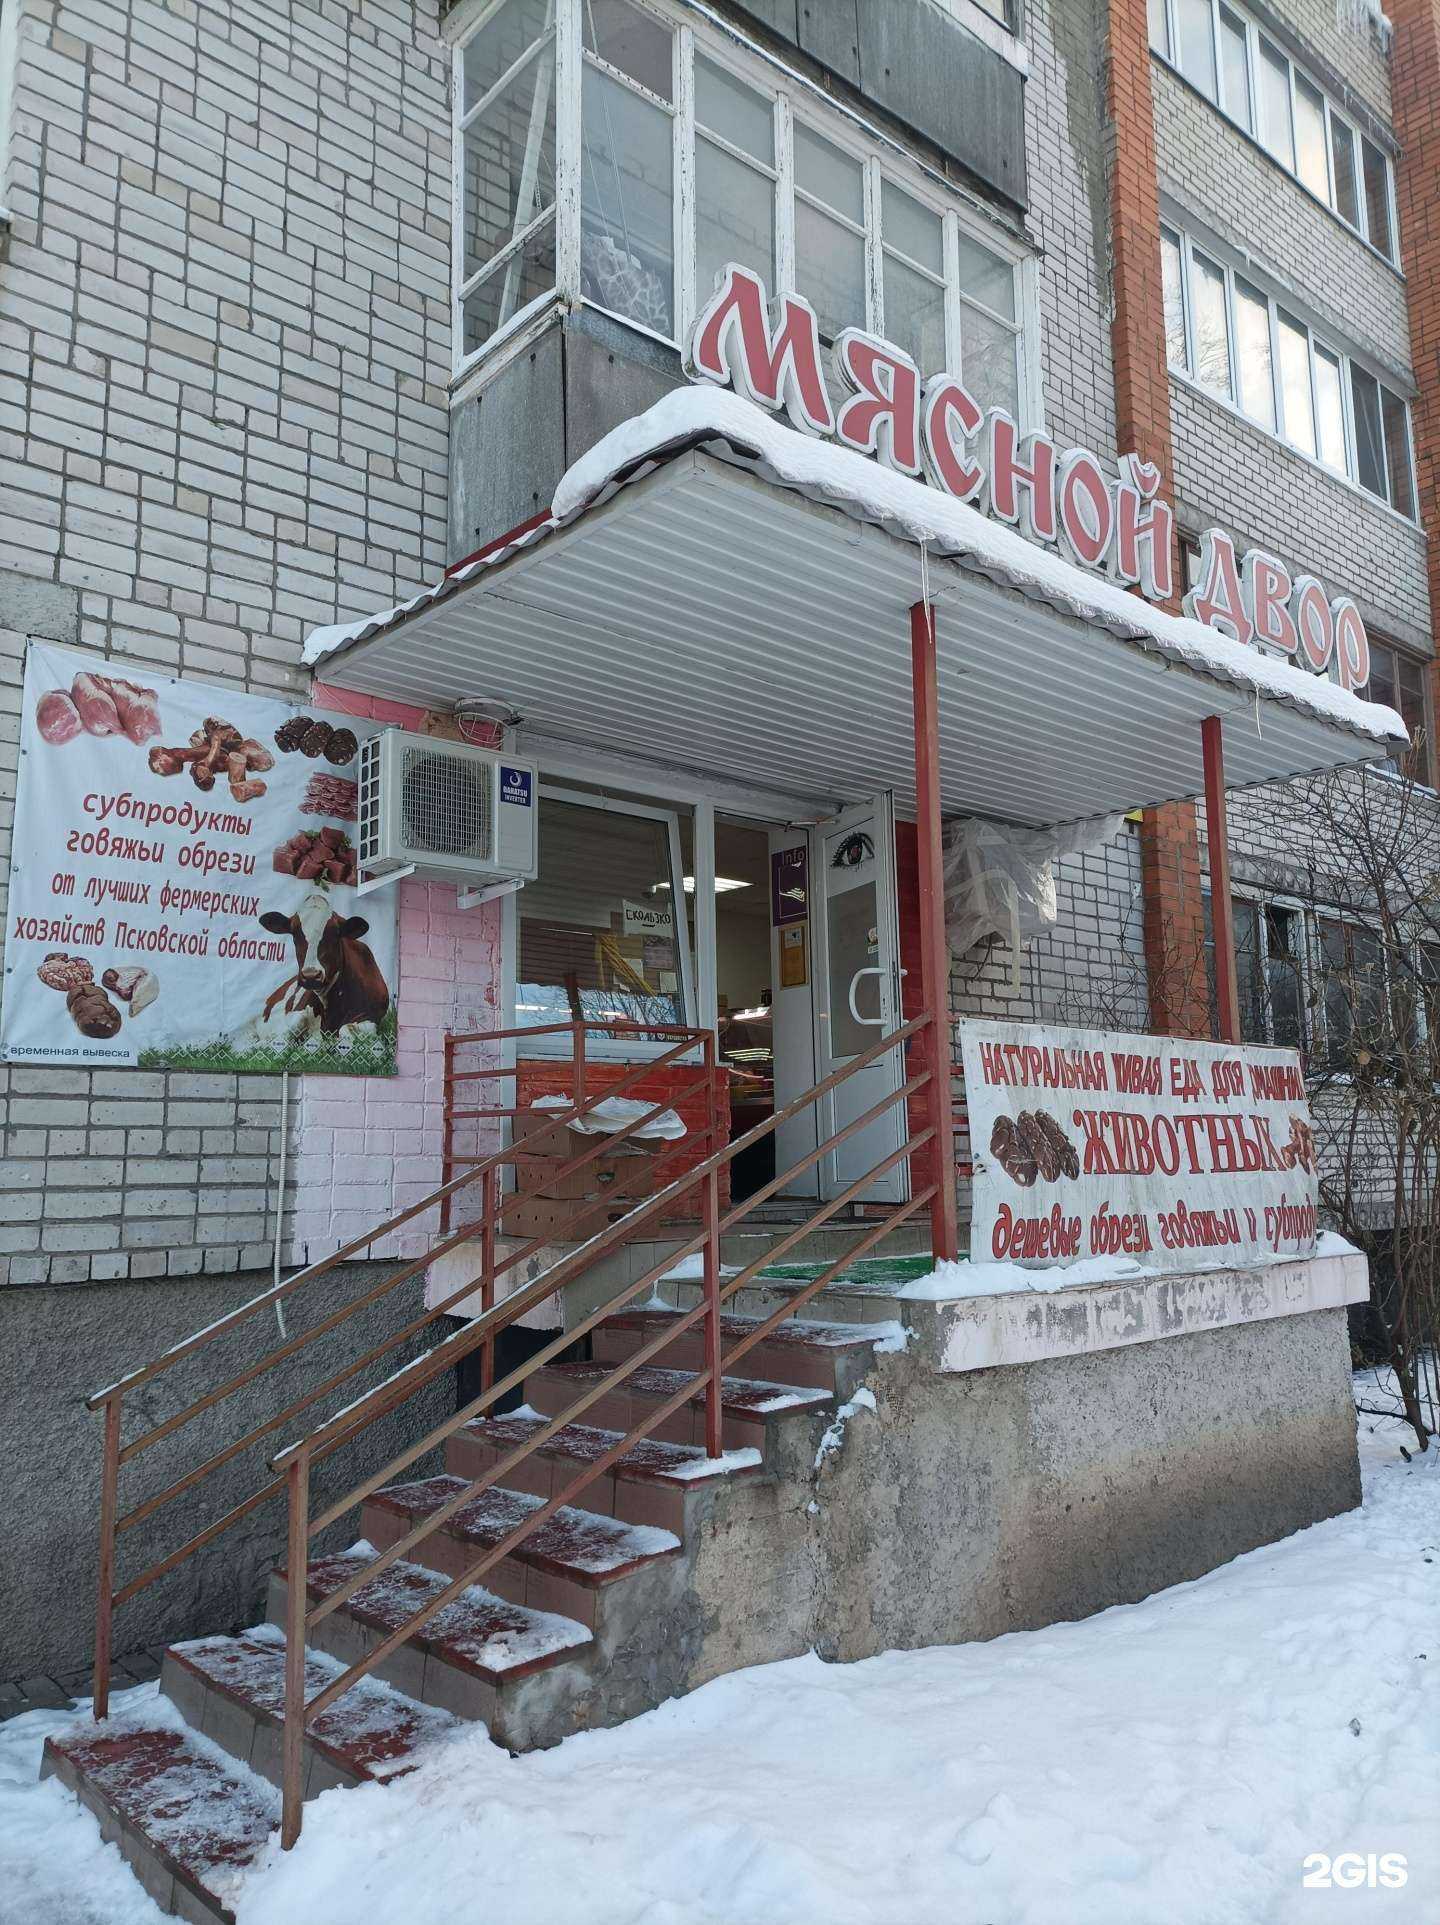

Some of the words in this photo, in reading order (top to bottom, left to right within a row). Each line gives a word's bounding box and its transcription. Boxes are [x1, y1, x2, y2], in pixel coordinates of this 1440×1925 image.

[83, 792, 253, 836] субпродукты
[66, 827, 165, 864] говяжьи
[178, 841, 257, 877] обрези
[52, 872, 76, 896] от
[84, 876, 151, 907] лучших
[160, 879, 261, 918] фермерских
[625, 908, 671, 925] СКОЛЬЗКО
[14, 914, 106, 947] хозяйств
[115, 921, 209, 957] Псковской
[218, 932, 286, 963] области
[10, 1046, 79, 1056] временная
[82, 1048, 130, 1058] вывеска
[979, 1042, 1109, 1091] НАТУРАЛЬНАЯ
[1170, 1057, 1207, 1104] ЕДА
[1211, 1060, 1246, 1104] ДЛЯ
[1072, 1109, 1287, 1176] ЖИВОТНЫХ
[991, 1202, 1082, 1259] дешевые
[1090, 1200, 1154, 1255] обрези
[1157, 1199, 1242, 1250] говяжьи
[1242, 1208, 1257, 1242] и
